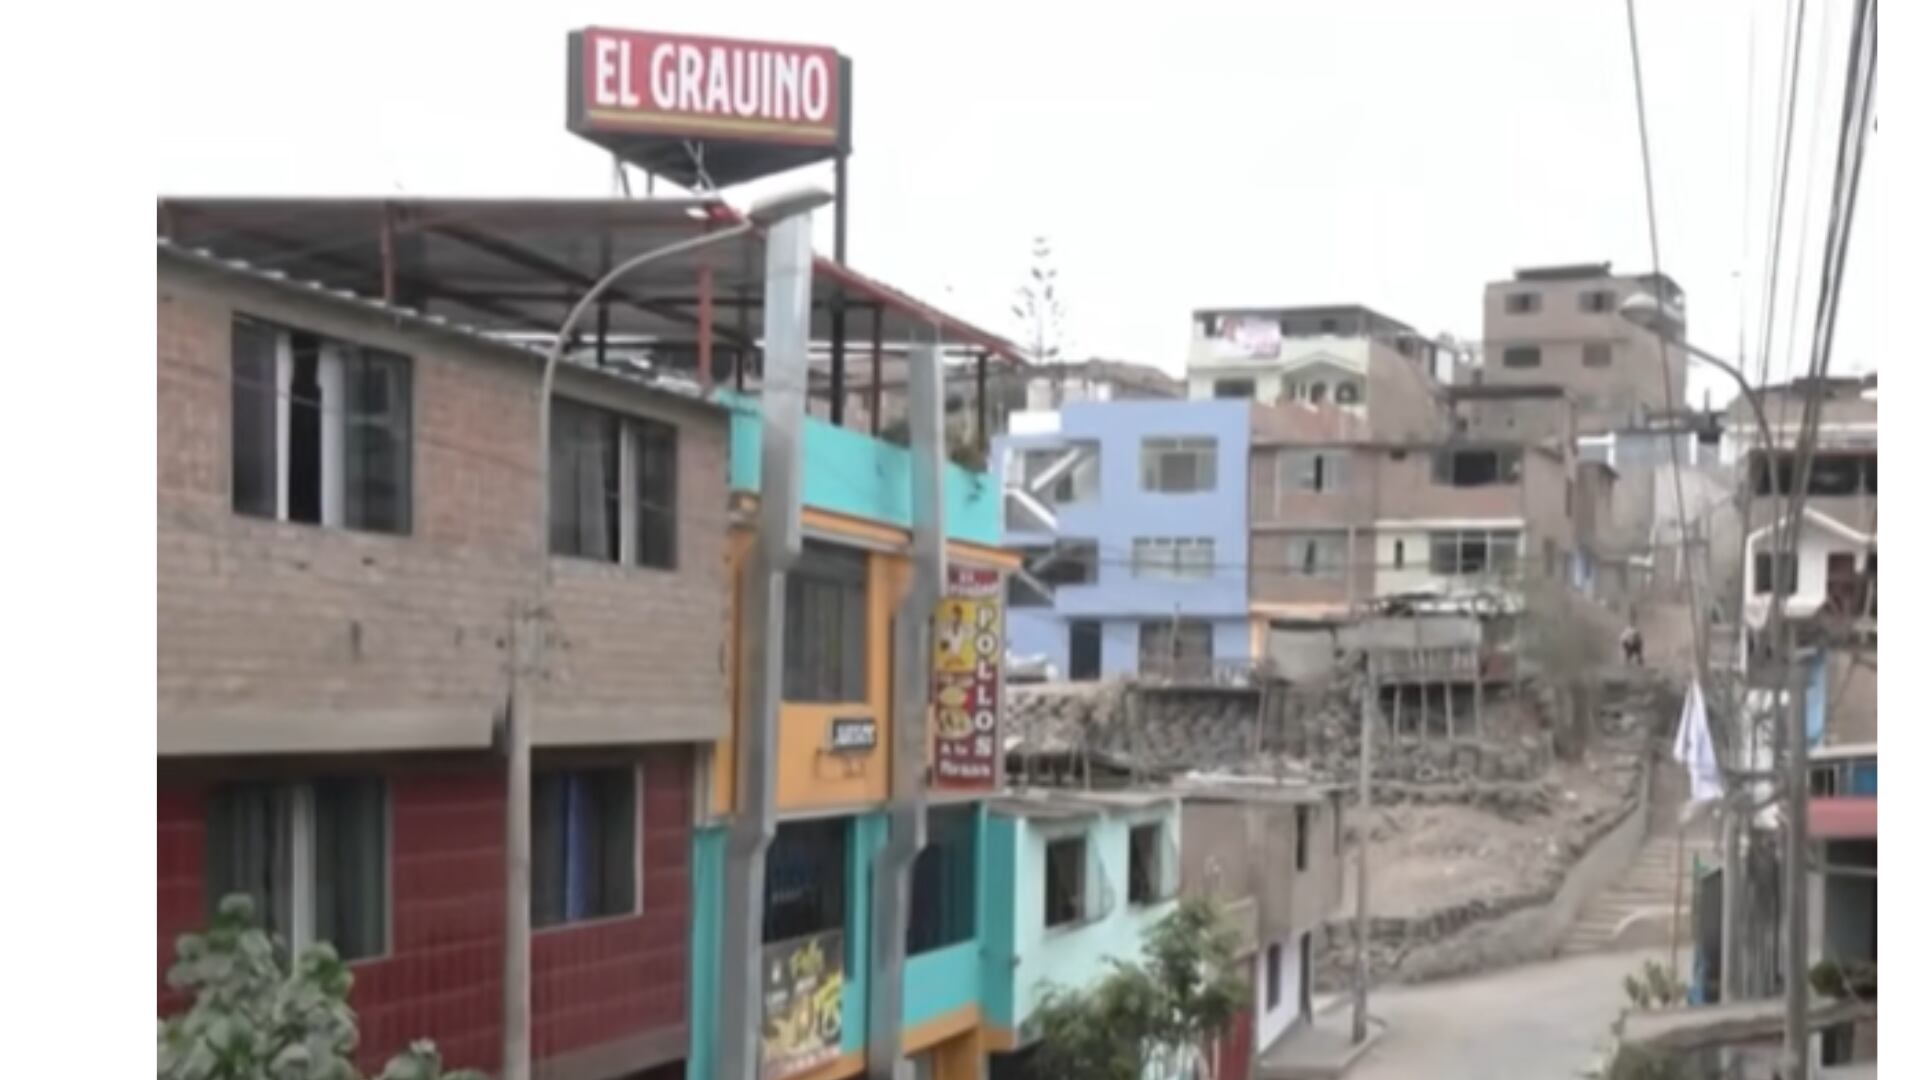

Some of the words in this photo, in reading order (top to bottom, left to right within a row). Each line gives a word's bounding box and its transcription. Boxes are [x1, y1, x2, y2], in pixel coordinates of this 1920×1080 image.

[595, 37, 640, 107] EL
[650, 42, 829, 121] GRAUINO
[976, 603, 996, 757] POLLOS
